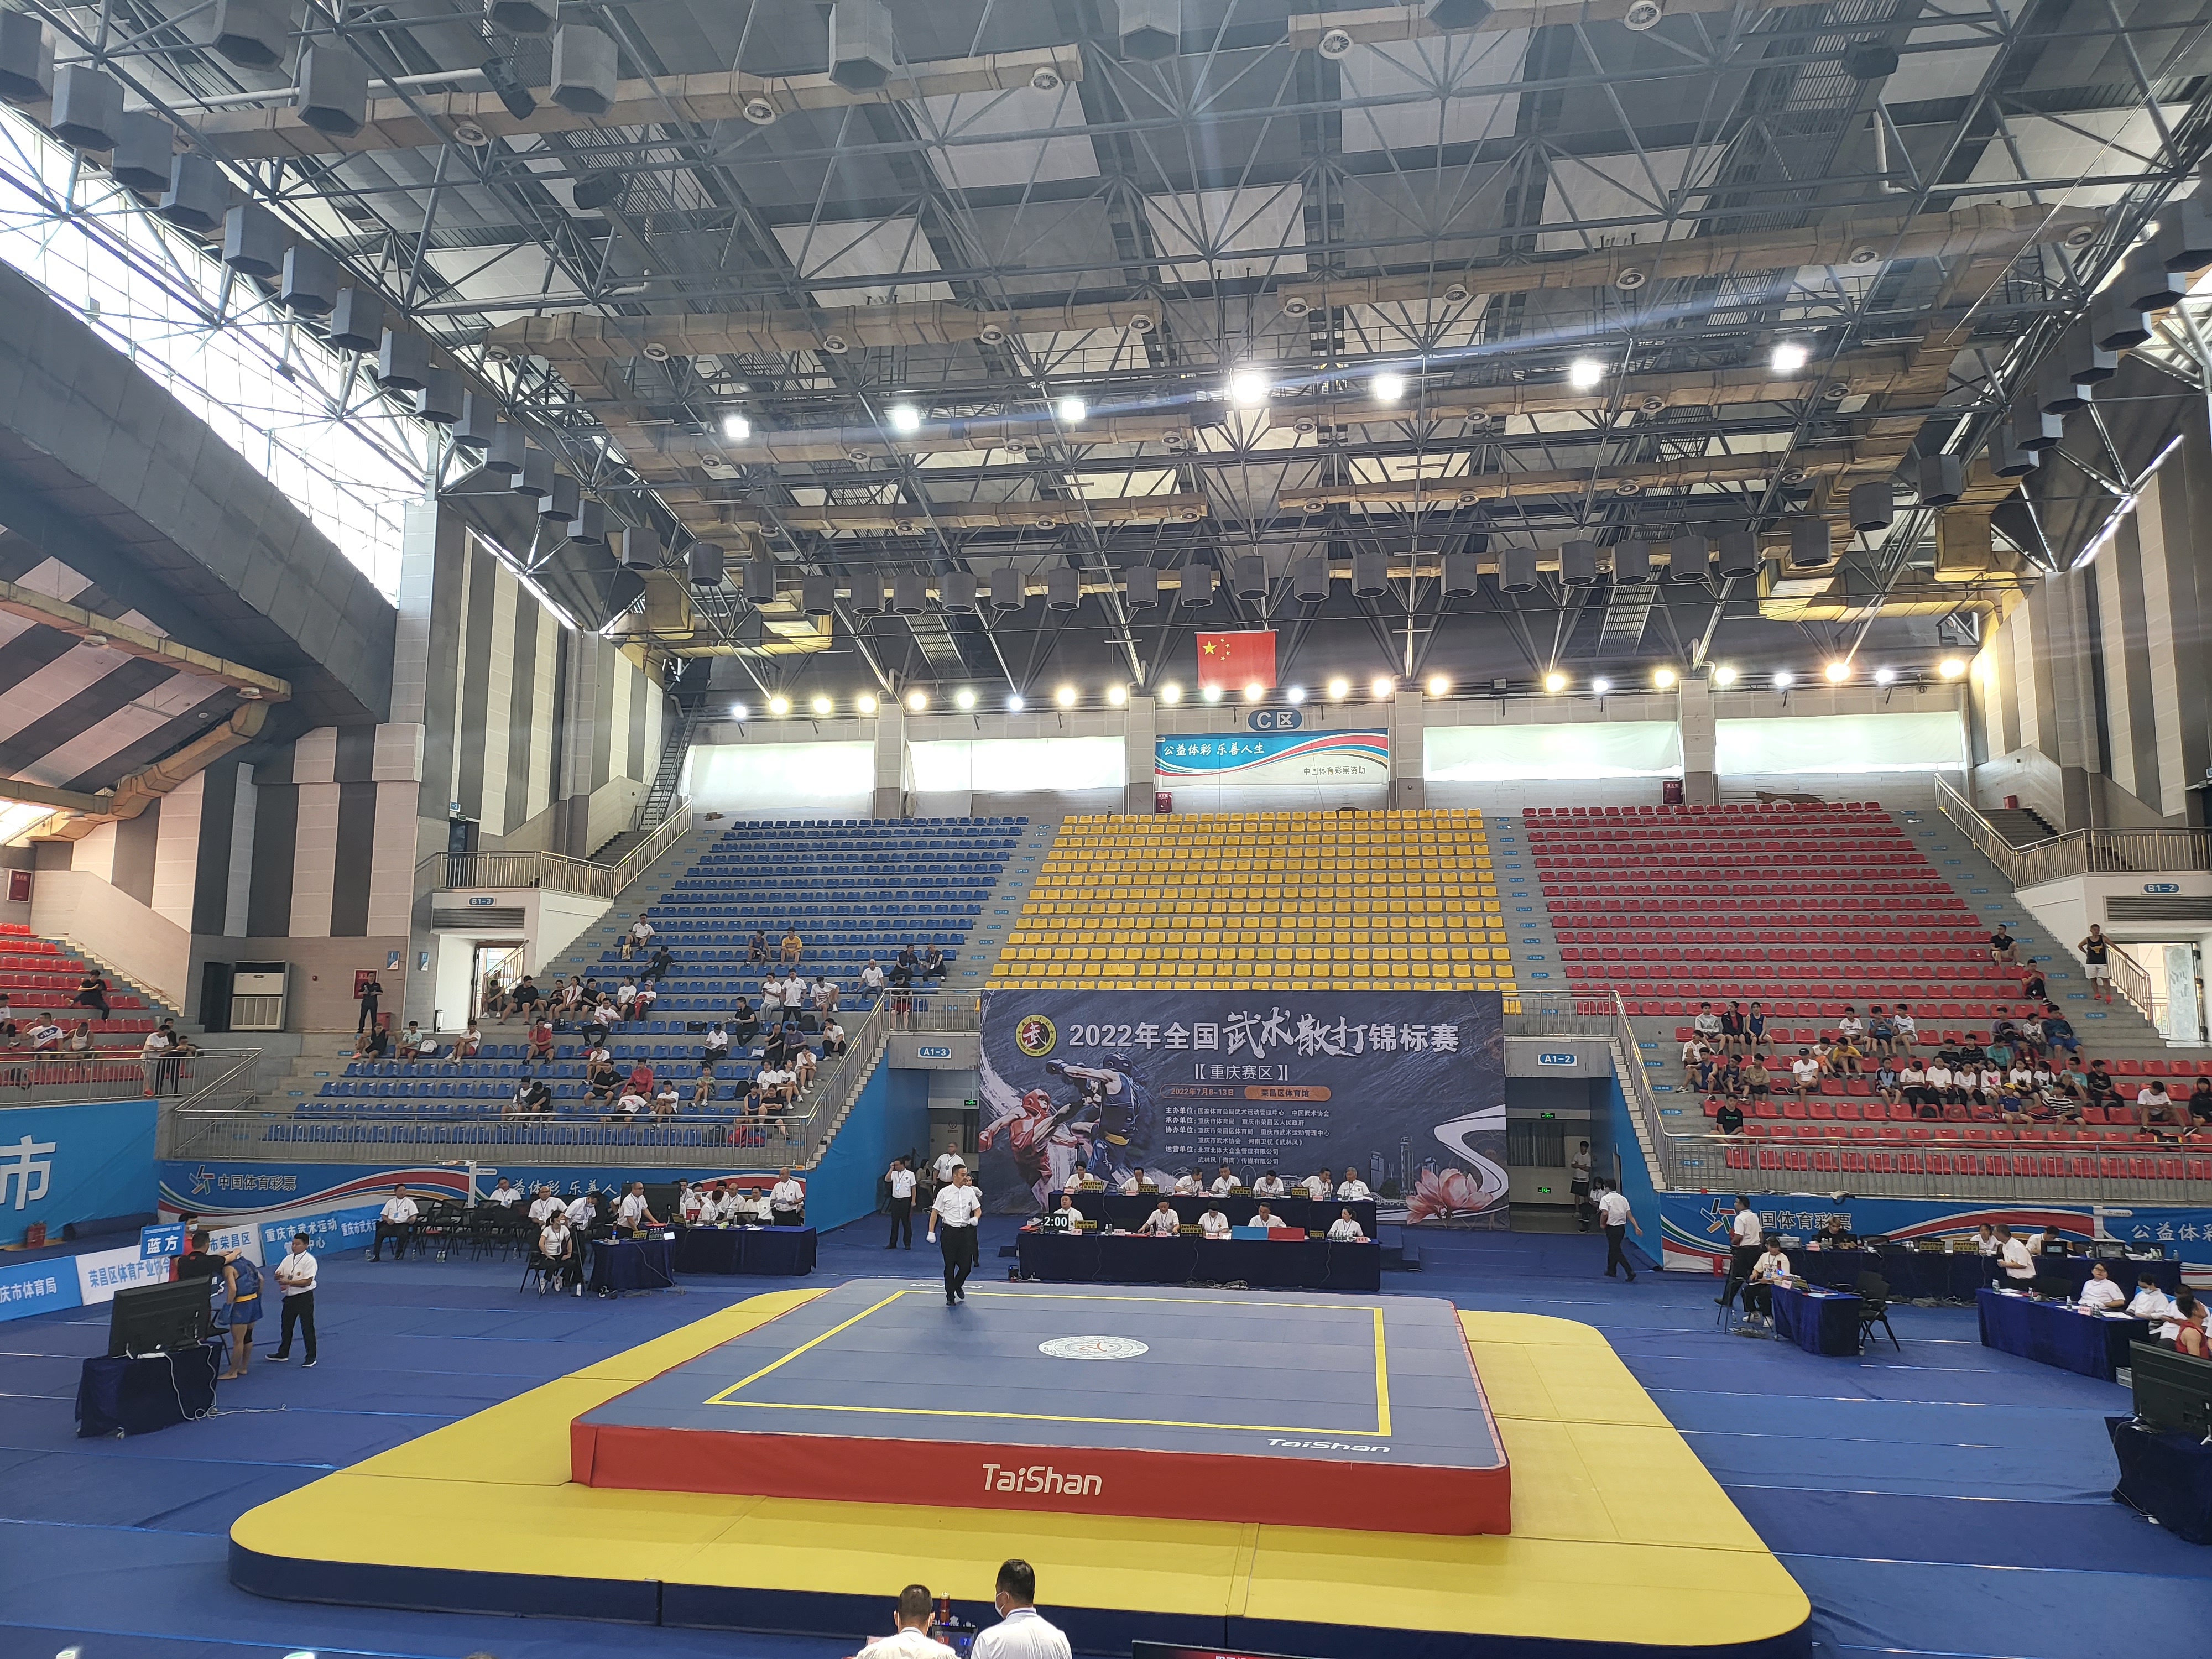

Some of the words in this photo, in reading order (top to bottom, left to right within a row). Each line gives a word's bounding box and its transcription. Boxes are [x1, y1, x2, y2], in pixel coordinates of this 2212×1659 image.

[1256, 711, 1293, 729] C区
[1164, 743, 1212, 756] 公益体彩
[1217, 742, 1265, 755] 乐善人生
[1303, 766, 1365, 775] 中国体育彩票资助
[2146, 884, 2177, 893] B1-2
[471, 897, 492, 905] B1-3
[1069, 1006, 1459, 1059] 2022年全国武术散打锦标赛
[1544, 1055, 1571, 1063] A1-2
[1261, 1089, 1310, 1098] 荣昌区体育馆
[1198, 1127, 1254, 1135] 重庆市荣昌区体育局
[0, 1135, 56, 1211] 市
[217, 1174, 297, 1191] 中国体育彩票
[495, 1178, 560, 1196] 益体彩
[568, 1178, 630, 1196] 乐善人
[1756, 1210, 1852, 1231] 国体育彩票
[265, 1218, 338, 1243] 重庆市武术运动
[146, 1235, 179, 1255] 蓝方
[284, 1236, 326, 1256] 管中心
[0, 1277, 57, 1303] 庆市体育局
[1266, 1438, 1391, 1454] TaiShan
[982, 1463, 1102, 1496] TaiShan
